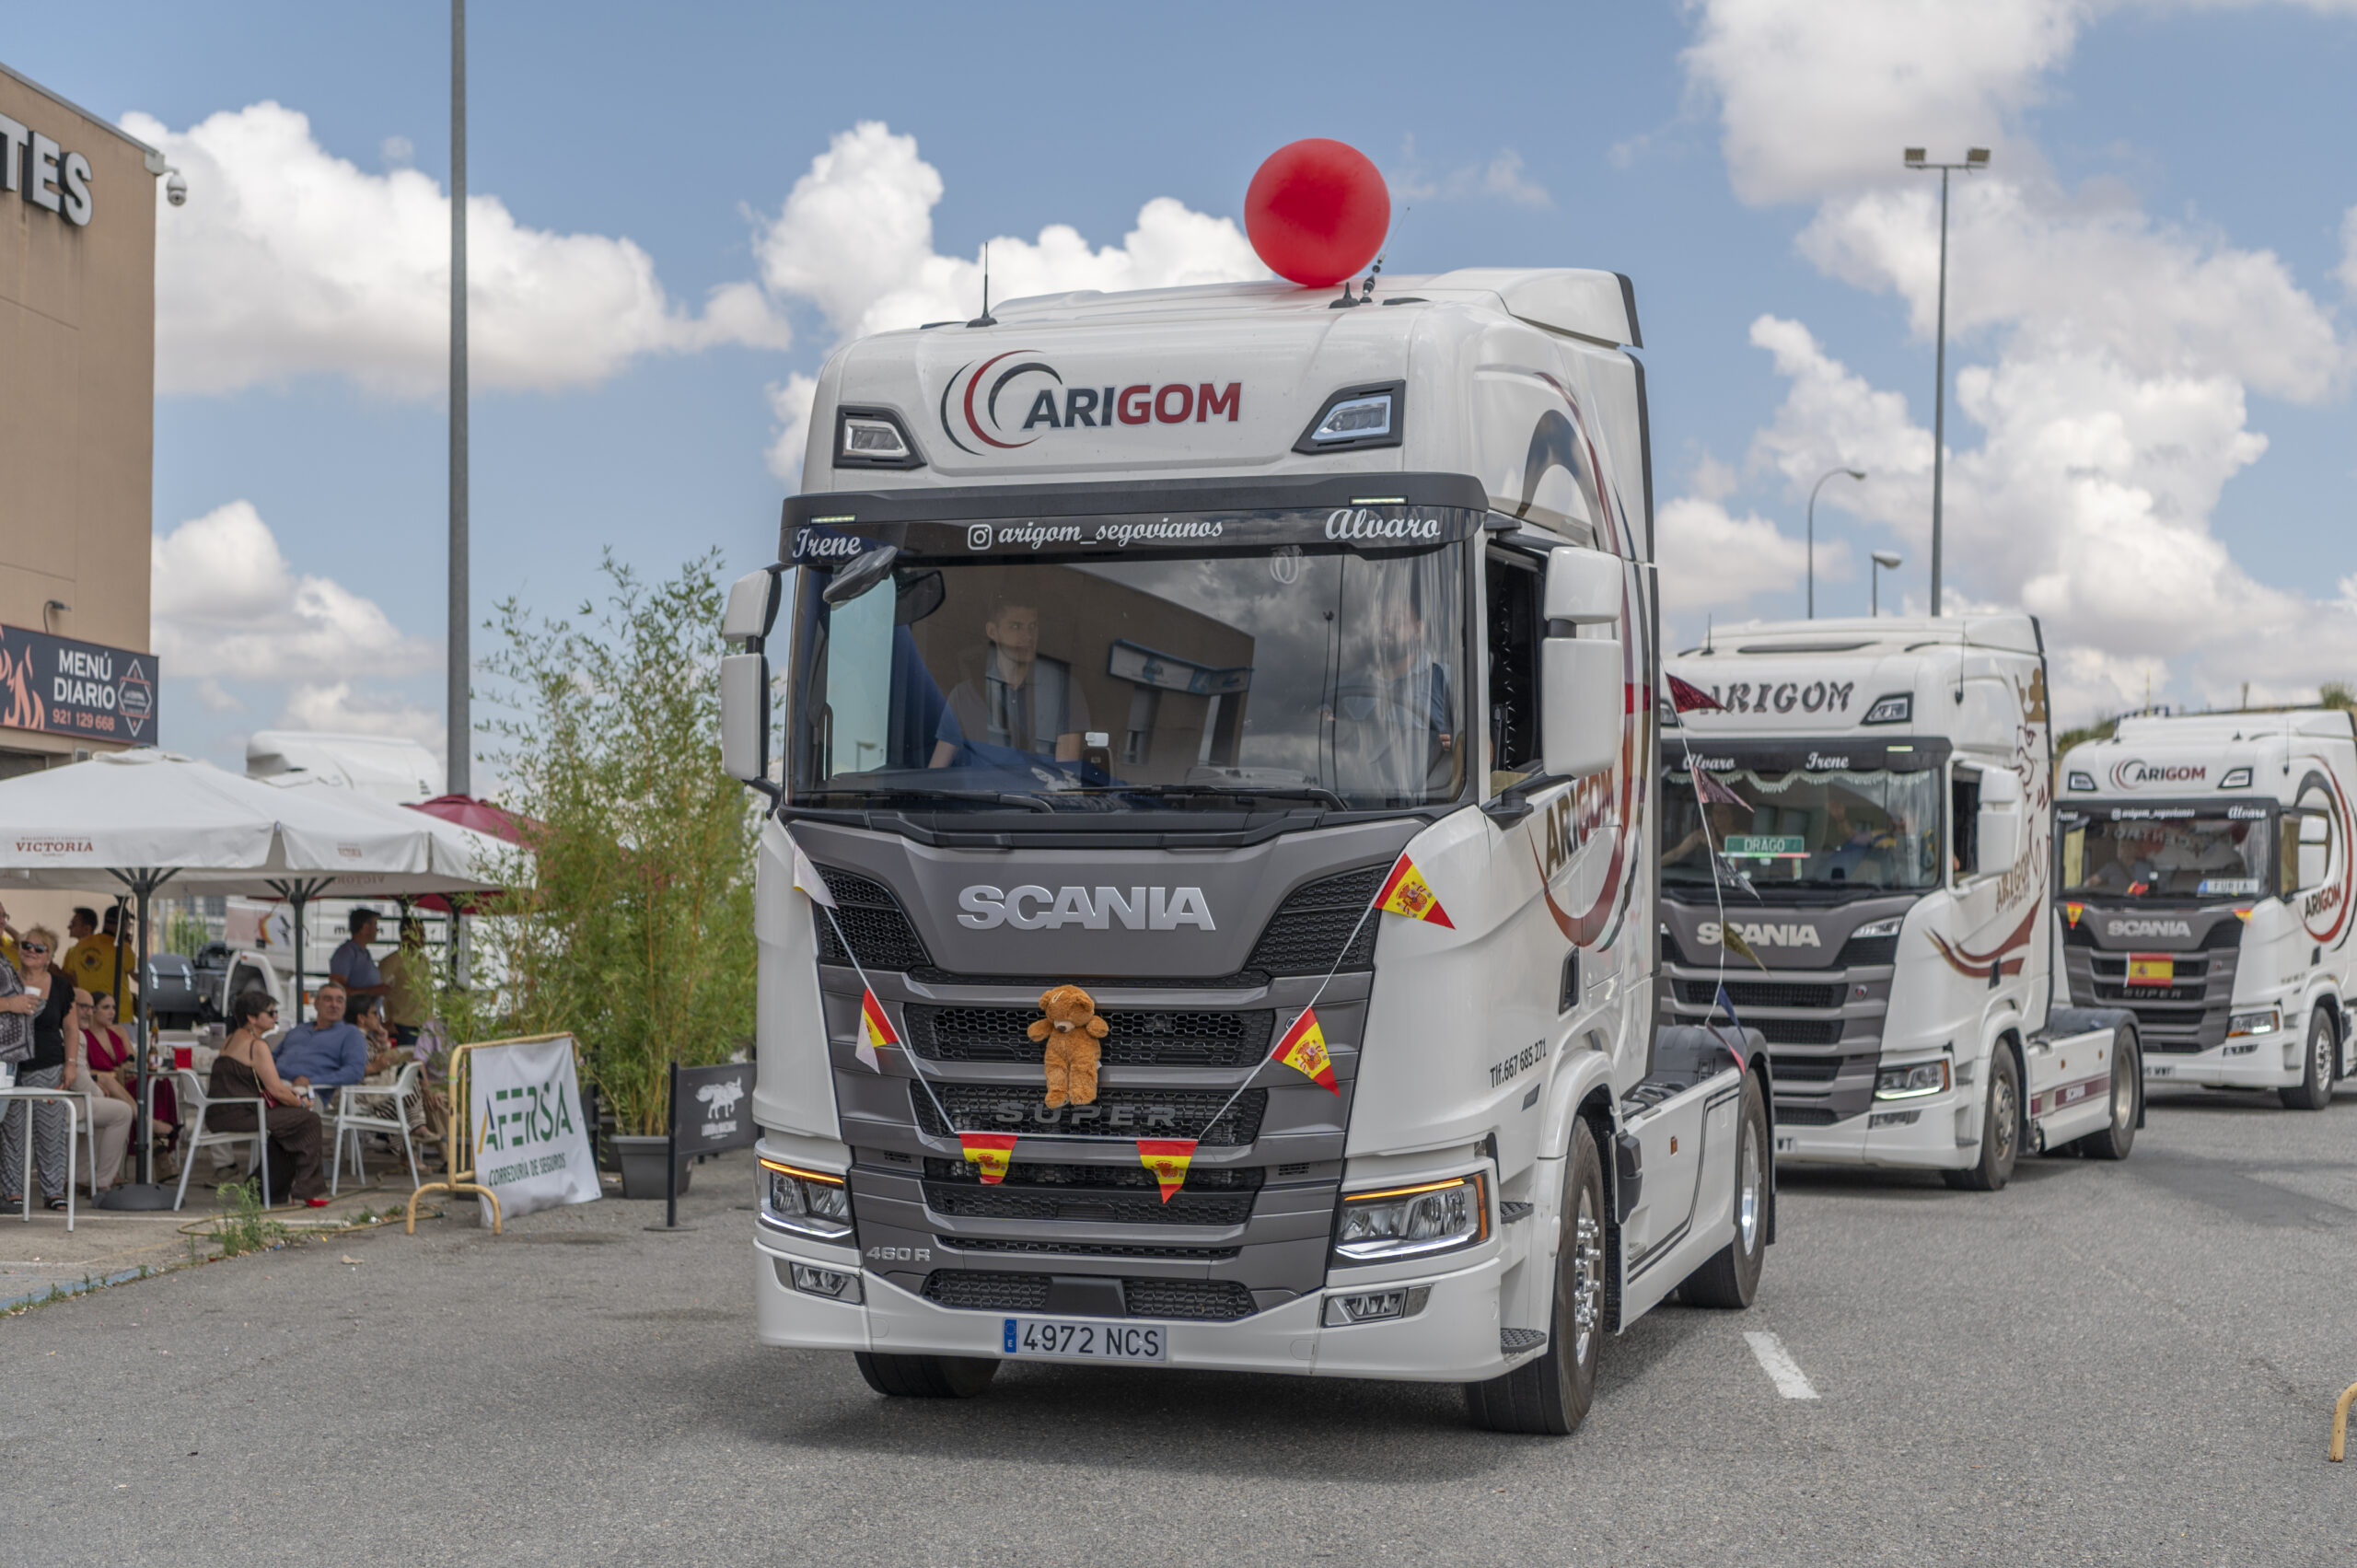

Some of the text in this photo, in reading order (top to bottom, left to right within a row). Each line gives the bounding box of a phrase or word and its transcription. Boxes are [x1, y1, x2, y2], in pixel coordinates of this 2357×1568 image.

[0, 112, 92, 226] TES
[1023, 382, 1242, 429] ARIGOM
[998, 517, 1223, 551] arigom_segovianos
[1325, 508, 1441, 540] Alvaro
[792, 528, 861, 558] Irene
[59, 648, 112, 681] MENÚ
[53, 677, 116, 710] DIARIO
[52, 708, 115, 732] 921 129 668
[1805, 752, 1849, 770] Irene
[2136, 766, 2206, 782] ARIGOM
[1546, 765, 1615, 880] ARIGOM
[16, 842, 94, 853] VICTORIA
[1744, 839, 1785, 852] DRAGO
[958, 885, 1216, 930] SCANIA
[2305, 882, 2341, 920] ARIGOM
[2107, 920, 2191, 937] SCANIA
[1519, 1045, 1533, 1072] 685
[1535, 1037, 1547, 1063] 271
[477, 1081, 574, 1155] AFERSA
[995, 1102, 1176, 1126] SUPER
[529, 1159, 540, 1177] DE
[540, 1152, 566, 1175] SEGUROS
[866, 1247, 930, 1261] 460 R
[1007, 1324, 1159, 1356] E 4972 NCS
